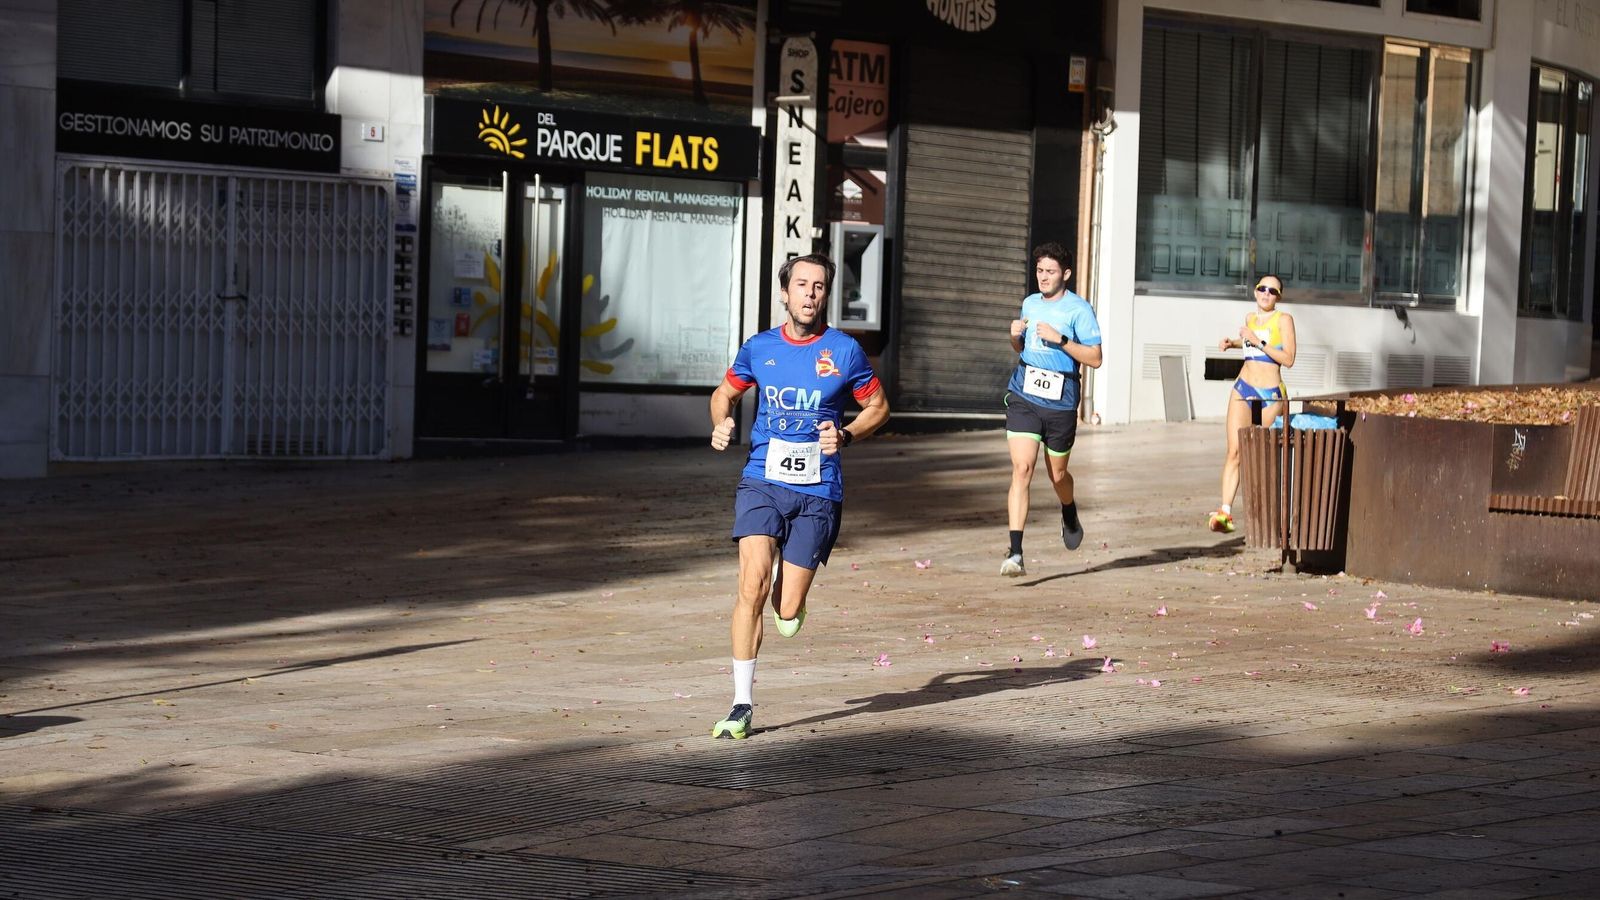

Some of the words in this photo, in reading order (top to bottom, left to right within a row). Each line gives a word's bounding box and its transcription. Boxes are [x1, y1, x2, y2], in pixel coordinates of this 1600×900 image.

[787, 48, 809, 58] SHOP
[829, 50, 885, 84] ATM
[537, 112, 557, 126] DEL
[59, 112, 191, 141] GESTIONAMOS
[200, 124, 223, 143] SU
[229, 126, 333, 151] PATRIMONIO
[536, 128, 623, 163] PARQUE
[635, 131, 719, 171] FLATS
[586, 186, 632, 200] HOLIDAY
[634, 190, 671, 203] RENTAL
[673, 193, 740, 207] MANAGEMENT
[1033, 378, 1051, 390] 40
[766, 386, 821, 410] RCM
[767, 416, 818, 431] 1873
[780, 457, 806, 471] 45
